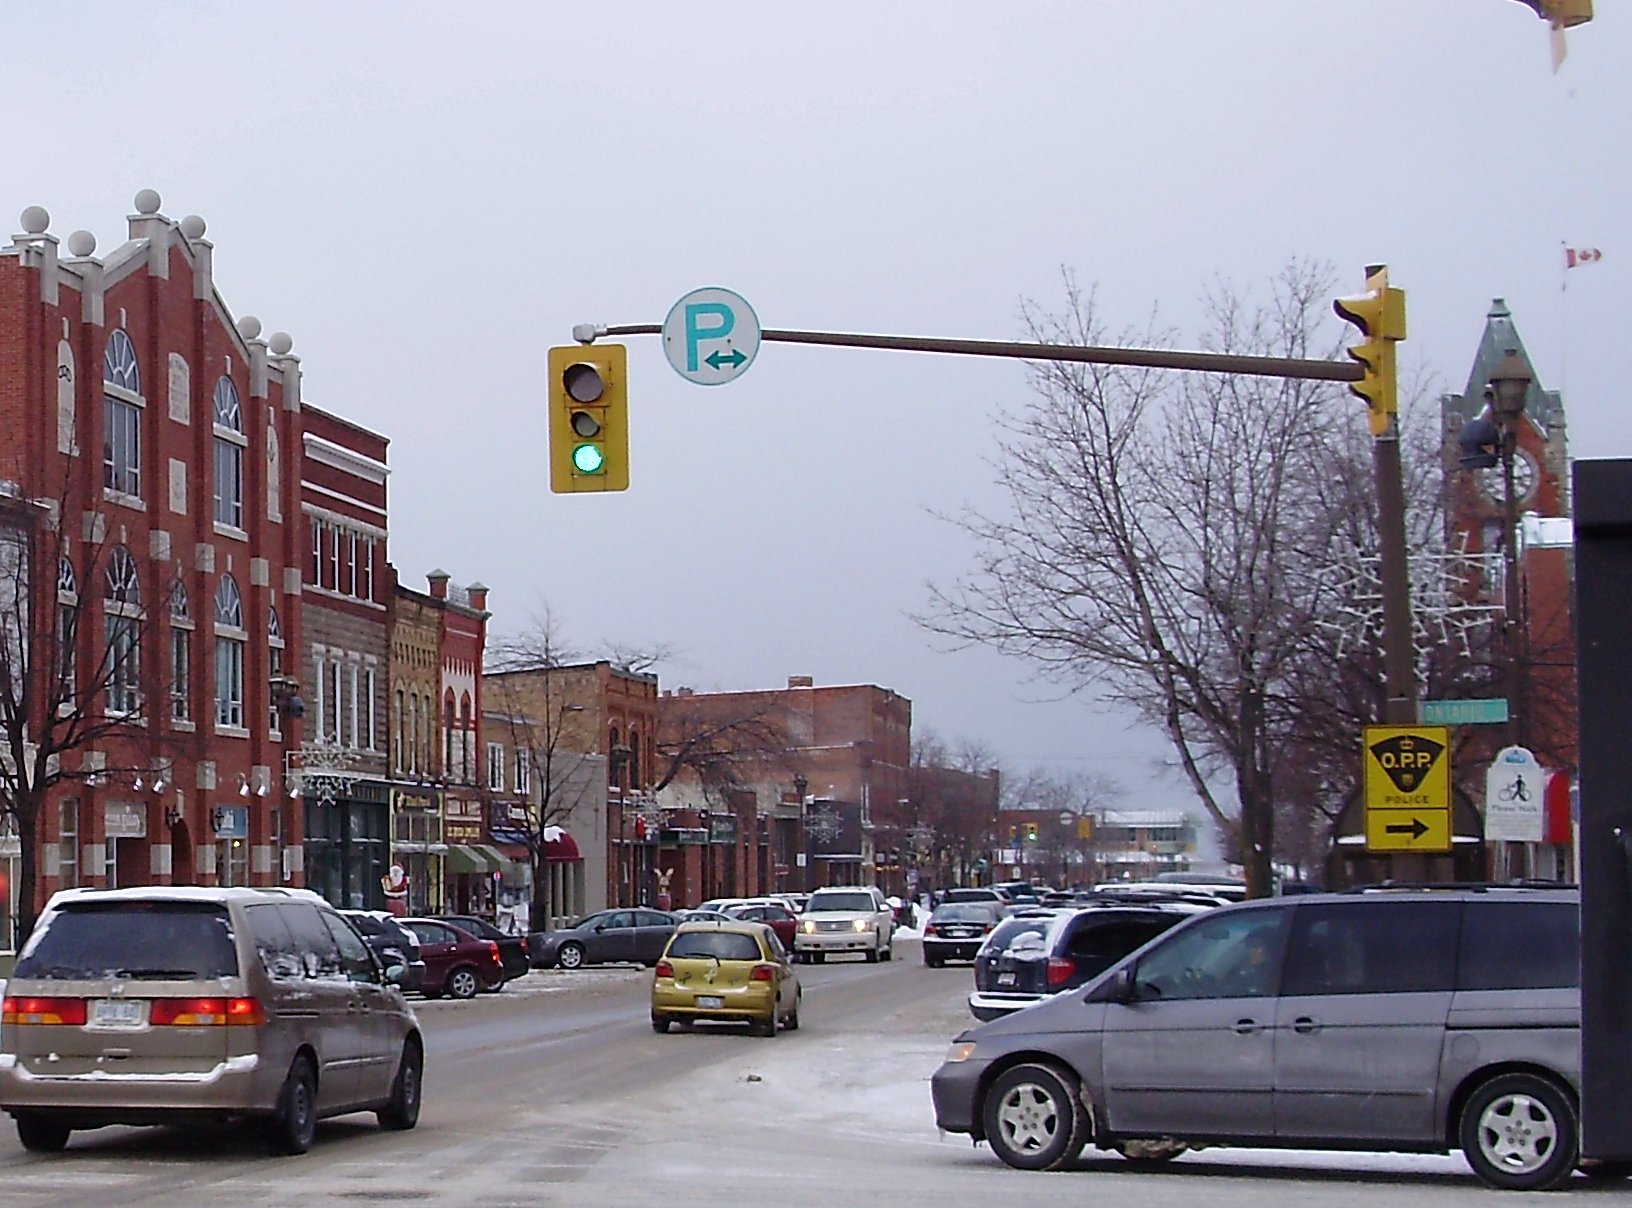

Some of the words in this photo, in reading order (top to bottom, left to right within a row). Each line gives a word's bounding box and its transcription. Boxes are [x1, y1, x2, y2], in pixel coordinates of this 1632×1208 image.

[685, 303, 734, 372] P
[1381, 752, 1432, 769] O.P.P.
[1385, 795, 1429, 804] POLICE
